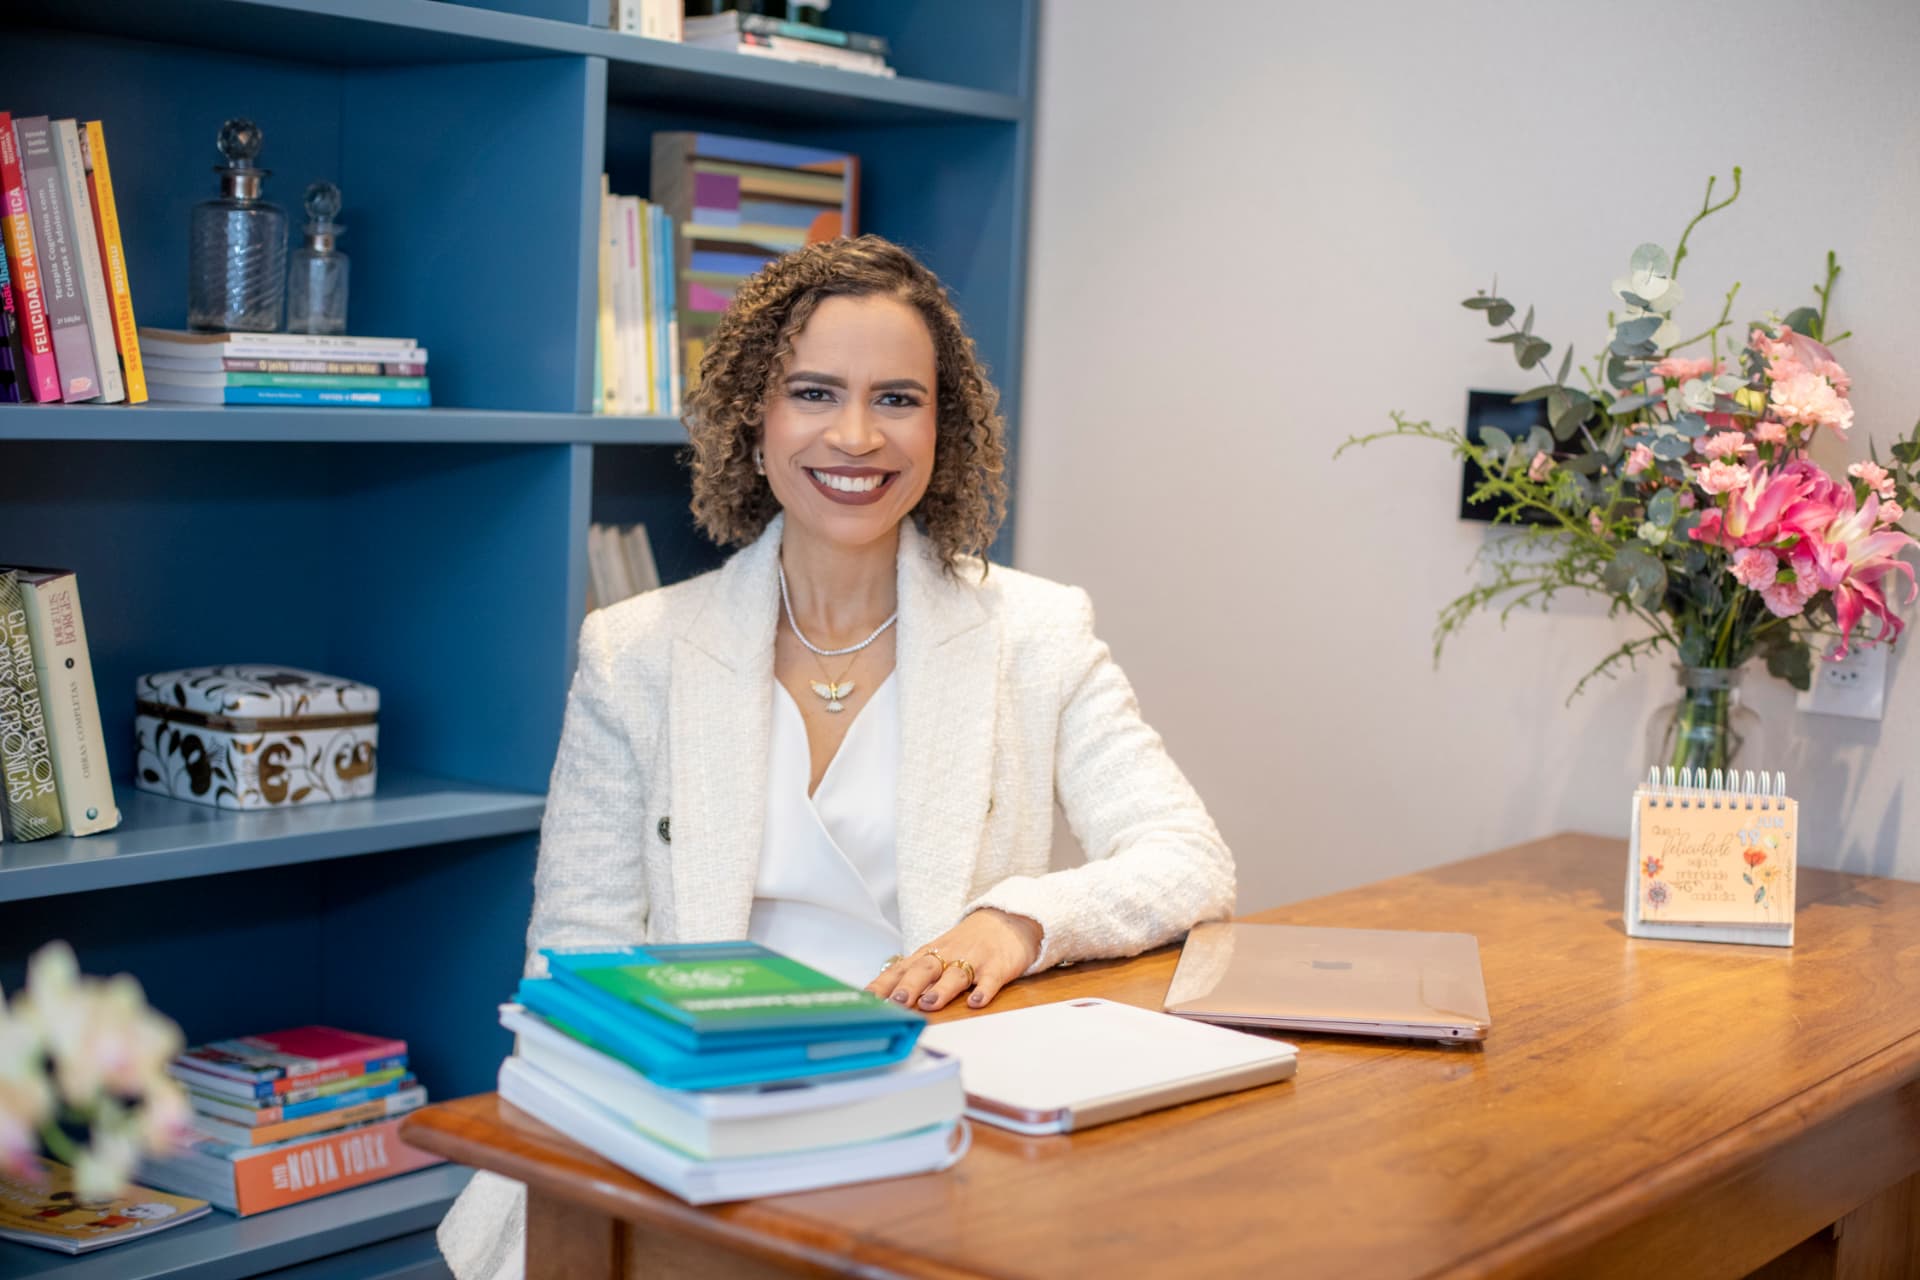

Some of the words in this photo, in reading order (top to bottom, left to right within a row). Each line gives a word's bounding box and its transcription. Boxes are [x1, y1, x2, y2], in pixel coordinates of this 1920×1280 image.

[12, 187, 34, 267] AUTÊNTICA
[39, 189, 47, 210] com
[48, 177, 64, 243] Adolescentes
[43, 213, 56, 260] Cognitiva
[52, 263, 62, 300] Terapia
[62, 255, 74, 298] Crianças
[22, 267, 48, 353] FELICIDADE
[111, 245, 125, 294] mentes
[119, 294, 137, 372] inquietas
[60, 591, 76, 645] BORGES
[8, 609, 36, 687] CLARICE
[0, 686, 18, 706] AS
[70, 680, 84, 741] COMPLETAS
[0, 708, 34, 803] CRÔNICAS
[20, 687, 55, 797] LISPECTOR
[80, 744, 90, 778] OBRAS
[286, 1143, 339, 1191] NOVA
[340, 1133, 388, 1176] YORK
